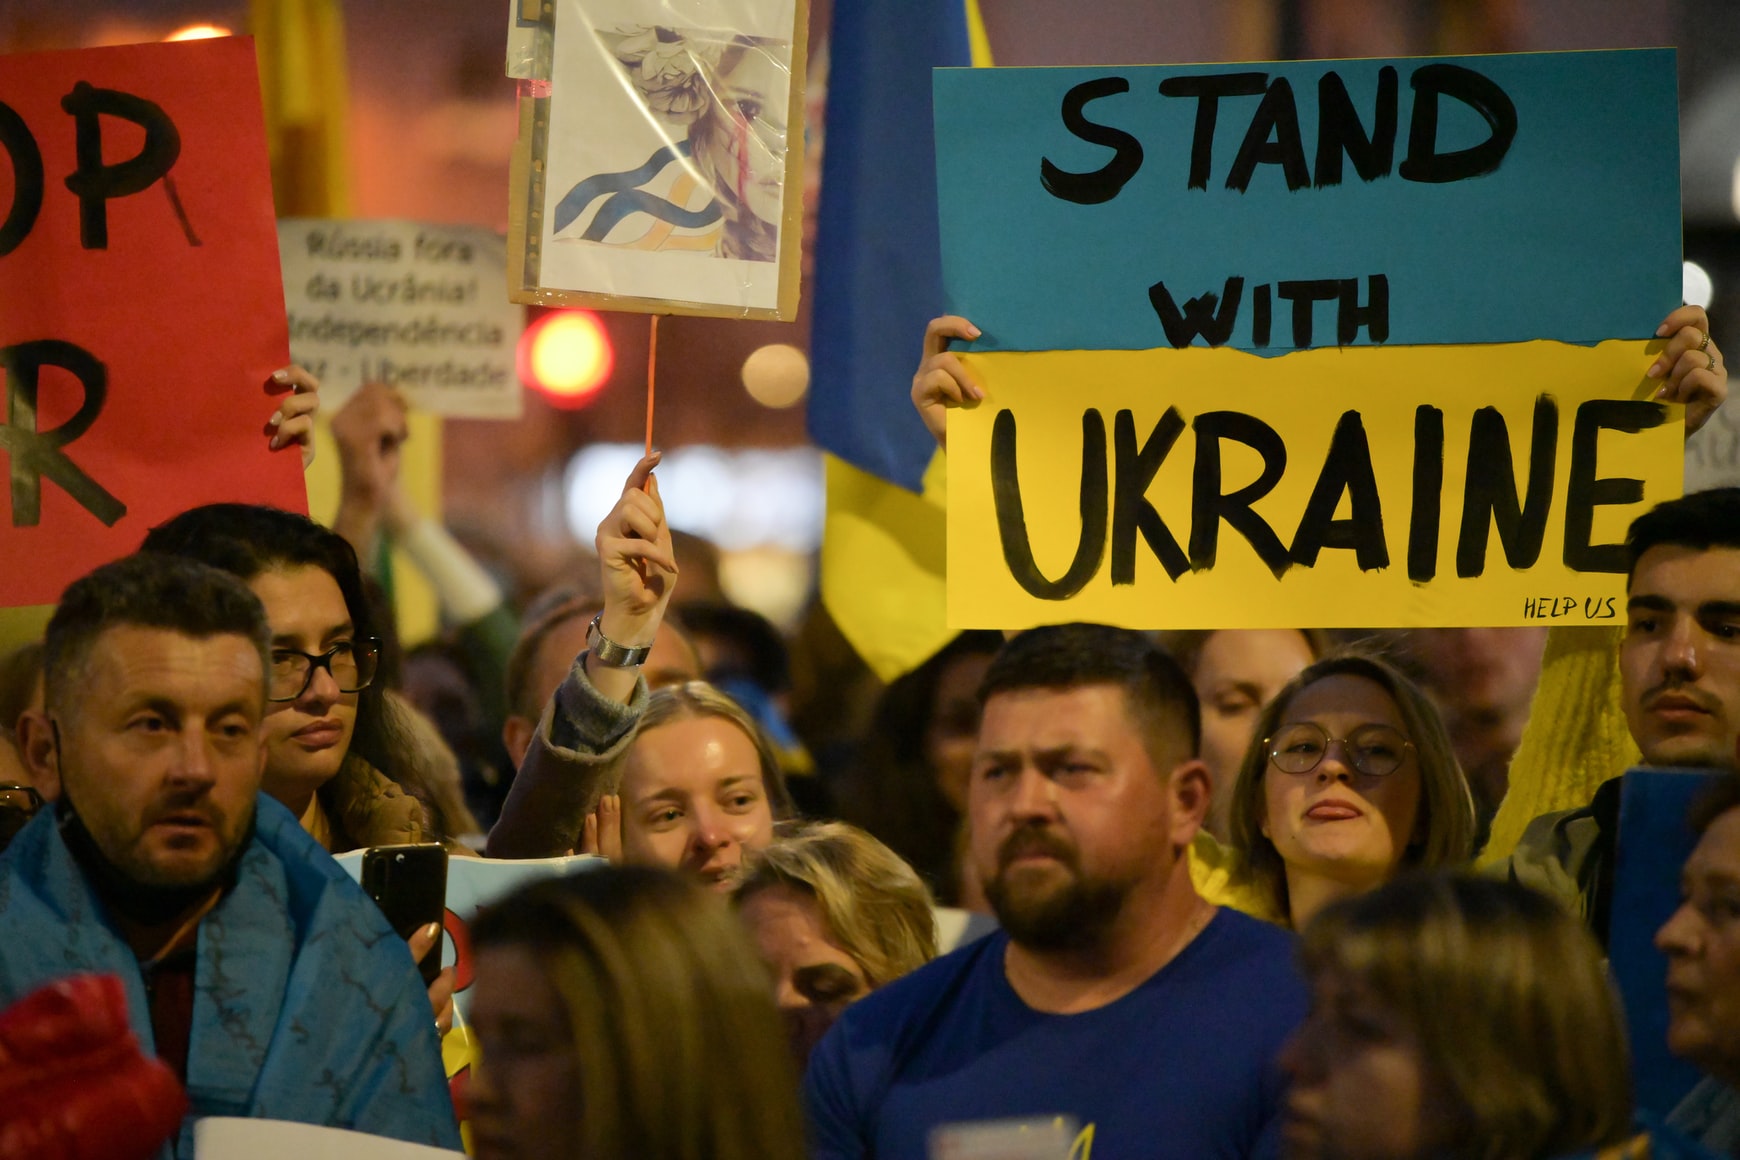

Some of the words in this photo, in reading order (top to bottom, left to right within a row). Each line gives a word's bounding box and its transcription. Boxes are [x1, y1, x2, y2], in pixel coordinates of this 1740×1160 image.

[1040, 64, 1518, 205] STAND
[415, 231, 473, 265] fora
[305, 271, 341, 301] da
[1148, 273, 1391, 350] WITH
[990, 393, 1671, 601] UKRAINE
[1524, 597, 1578, 619] HELP
[1585, 597, 1616, 619] US
